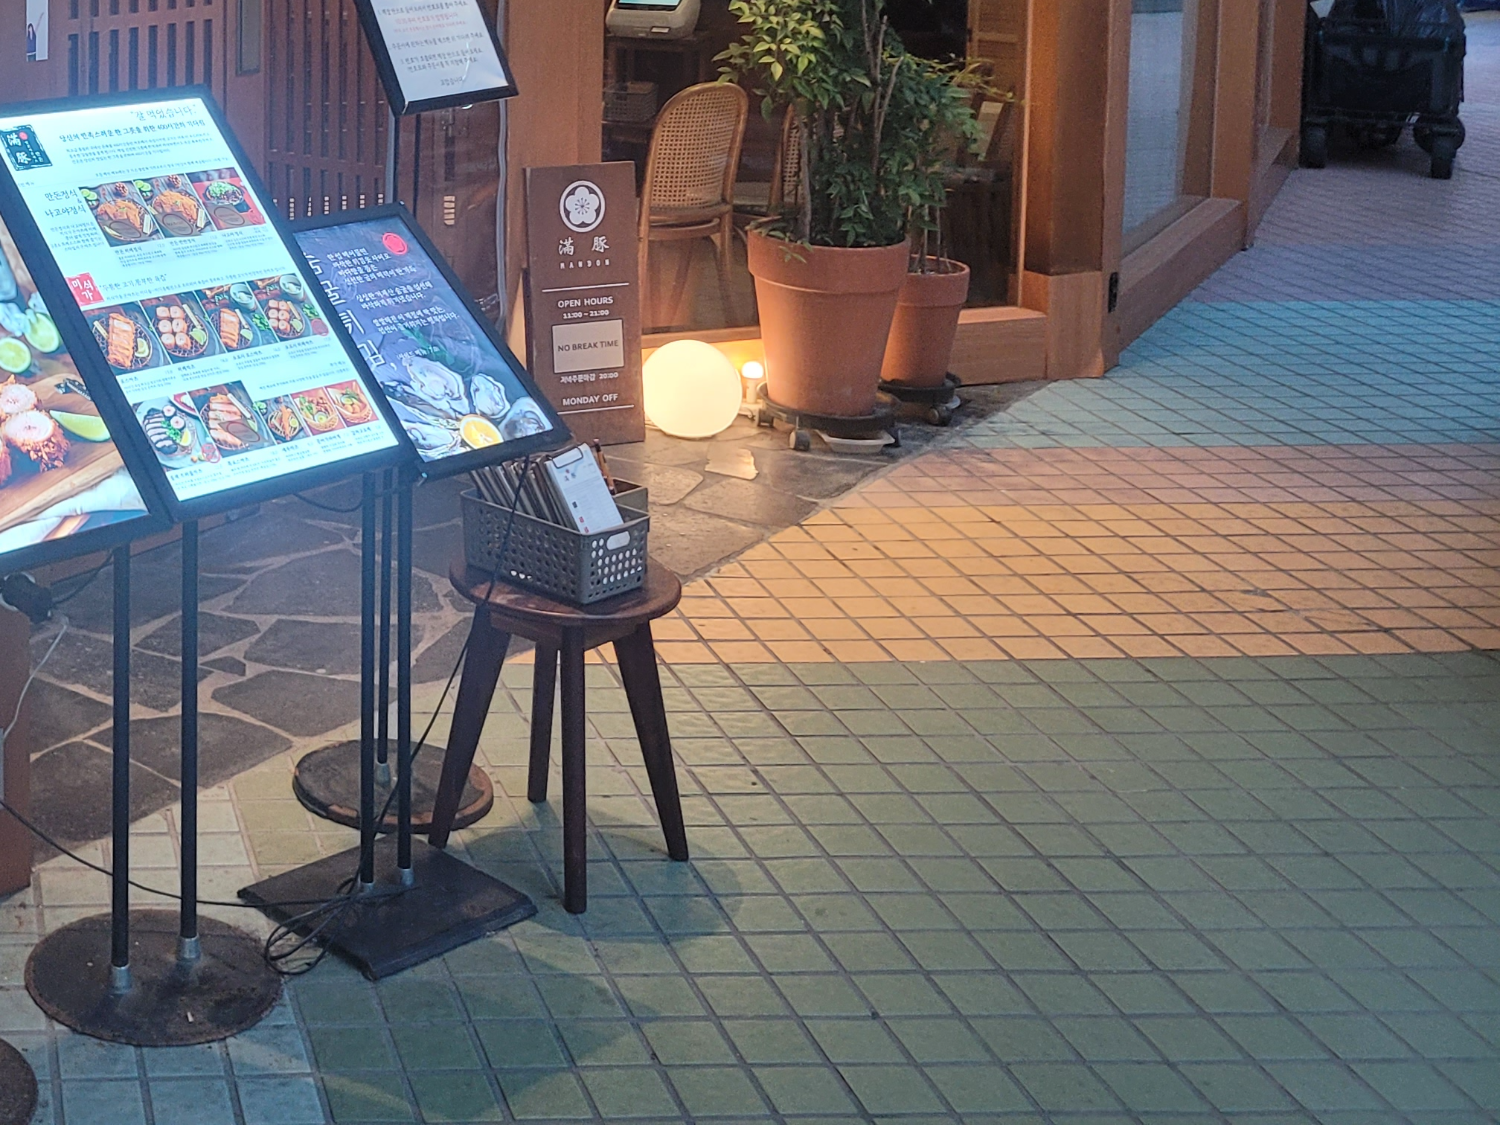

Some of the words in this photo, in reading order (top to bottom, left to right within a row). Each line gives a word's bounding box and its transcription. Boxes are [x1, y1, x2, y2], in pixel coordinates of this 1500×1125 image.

[43, 188, 78, 201] 만돈정식
[43, 204, 86, 218] 나고야정식
[558, 299, 581, 308] OPEN
[584, 296, 613, 305] HOURS
[558, 343, 570, 352] NO
[572, 341, 598, 351] BREAK
[600, 340, 619, 349] TIME
[562, 395, 600, 406] MONDAY
